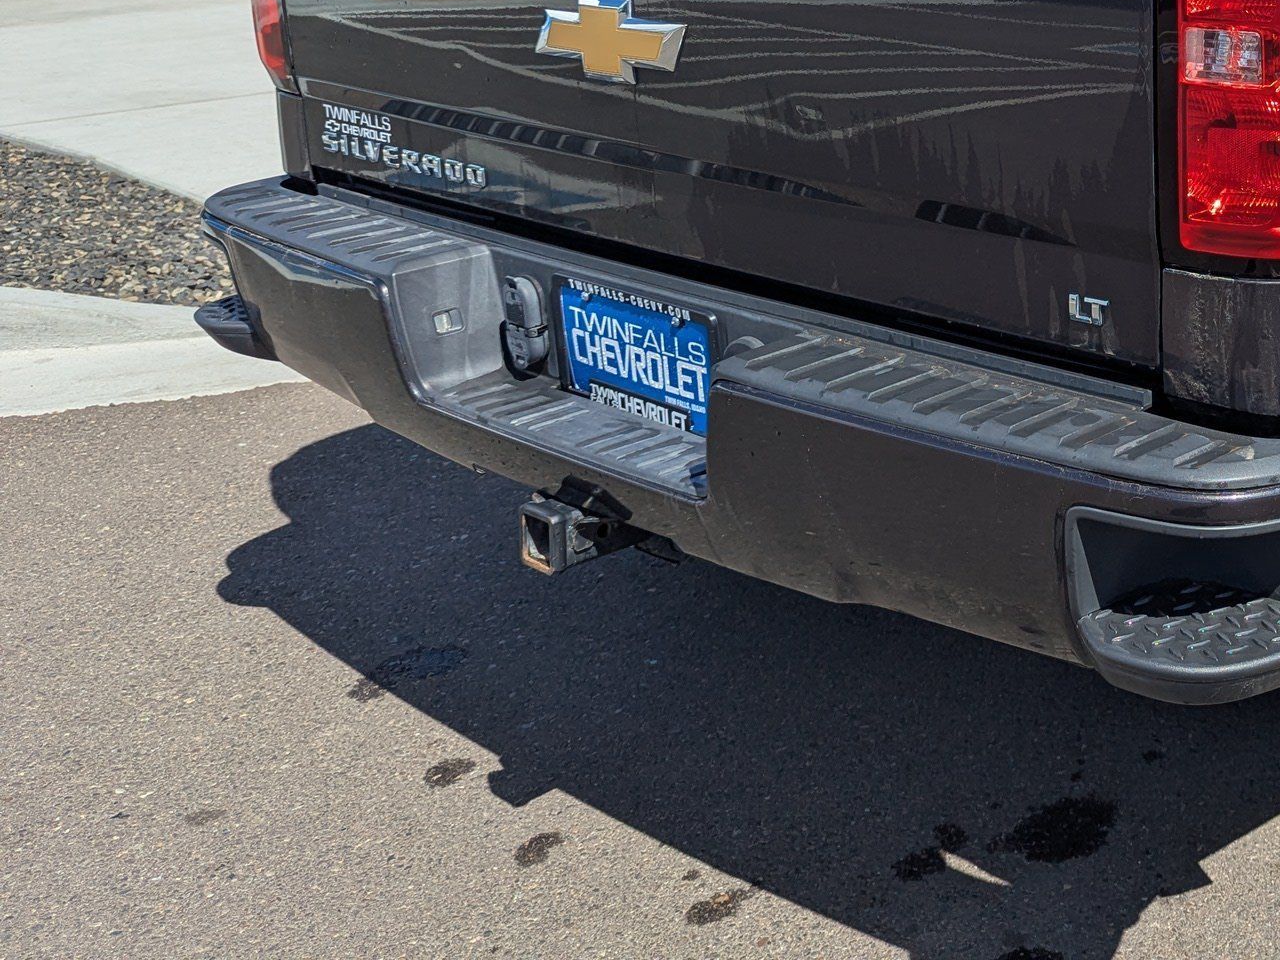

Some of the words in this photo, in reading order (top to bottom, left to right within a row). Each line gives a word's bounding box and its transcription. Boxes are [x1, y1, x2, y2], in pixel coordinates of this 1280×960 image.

[322, 103, 392, 132] TWINFALLS
[341, 122, 393, 144] CHEVROLET
[321, 130, 488, 189] SILVERADO
[568, 278, 691, 321] TWINFALLS-CHEVY.COM
[1068, 293, 1110, 327] LT
[568, 305, 707, 366] TWINFALLS
[571, 327, 708, 403] CHEVROLET
[589, 383, 619, 403] TWIN
[617, 391, 688, 431] CHEVROLET
